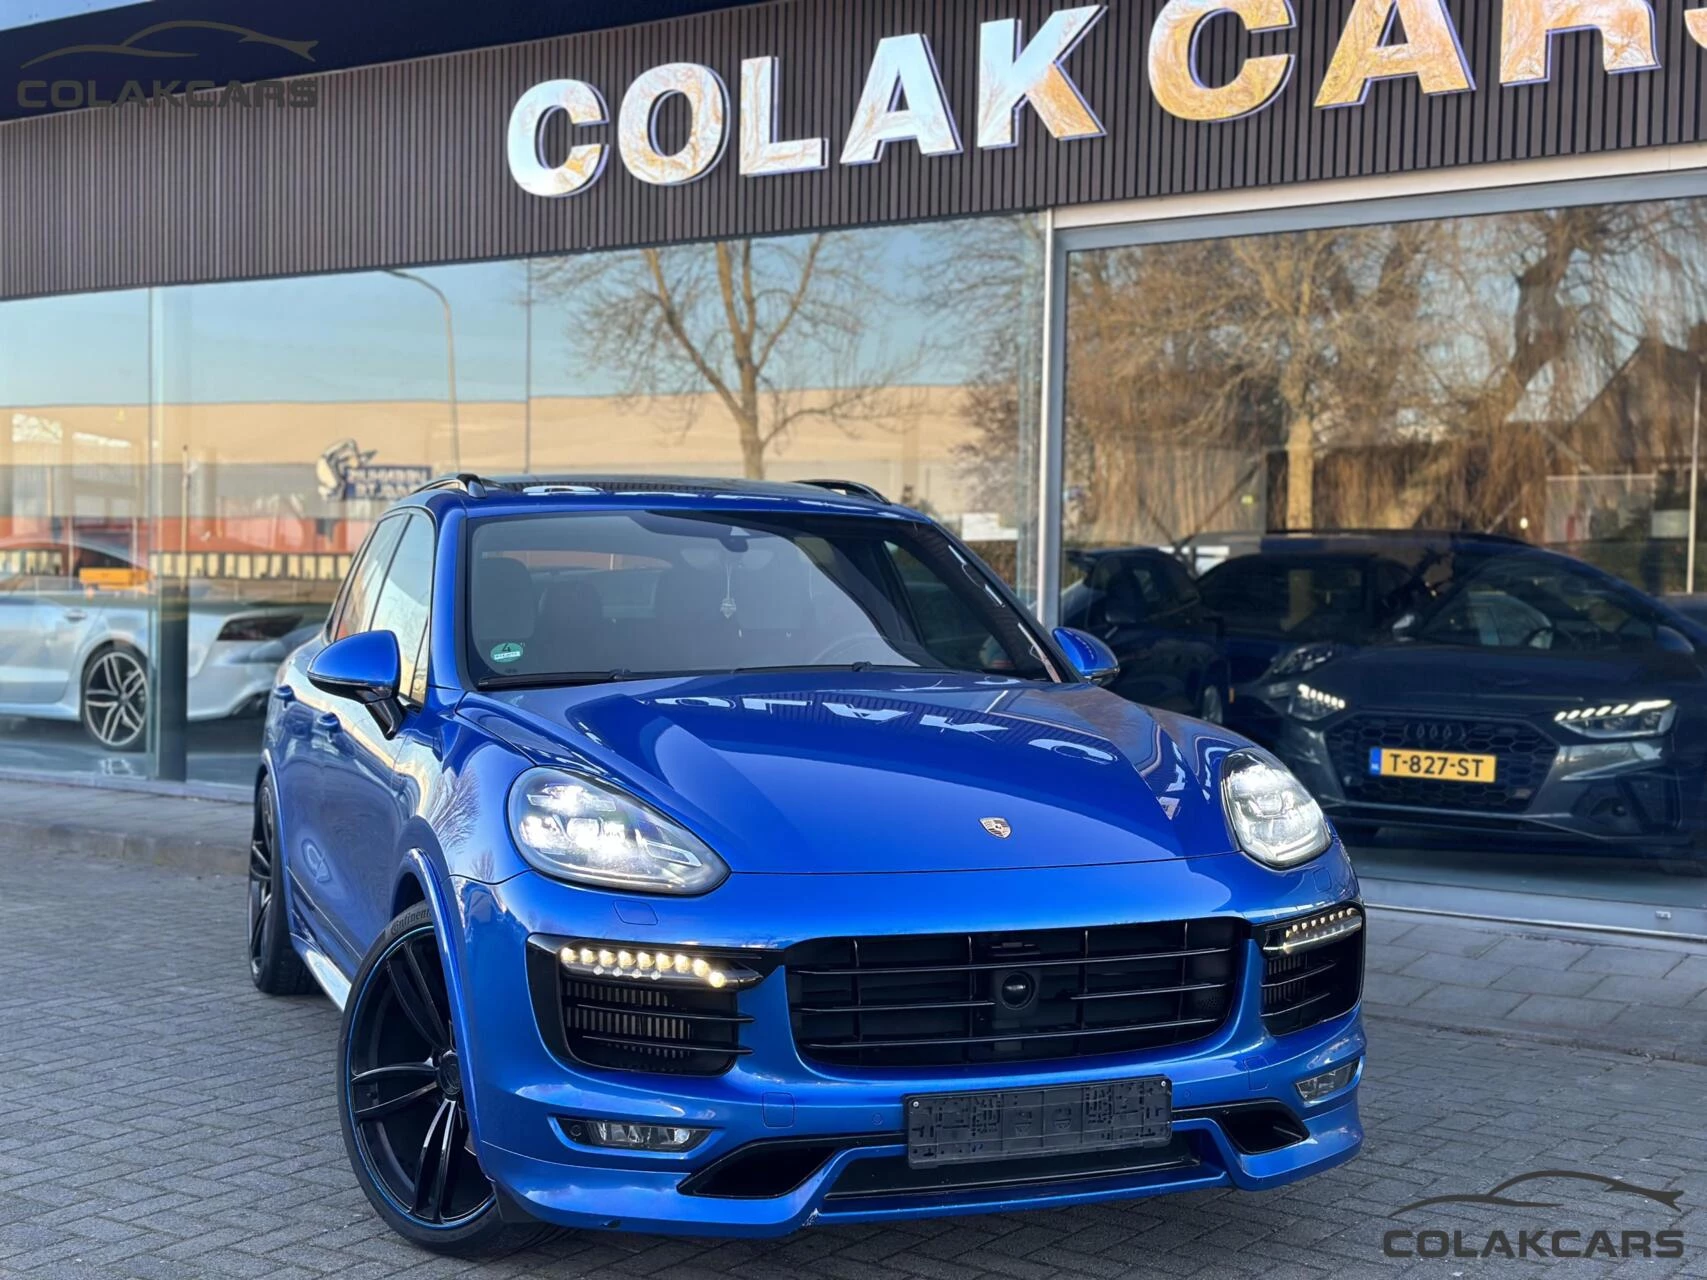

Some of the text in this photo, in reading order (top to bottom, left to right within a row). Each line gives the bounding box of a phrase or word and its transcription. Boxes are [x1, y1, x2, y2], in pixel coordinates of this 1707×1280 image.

[507, 0, 1707, 198] COLAK CAR
[1389, 752, 1484, 778] T-827-ST
